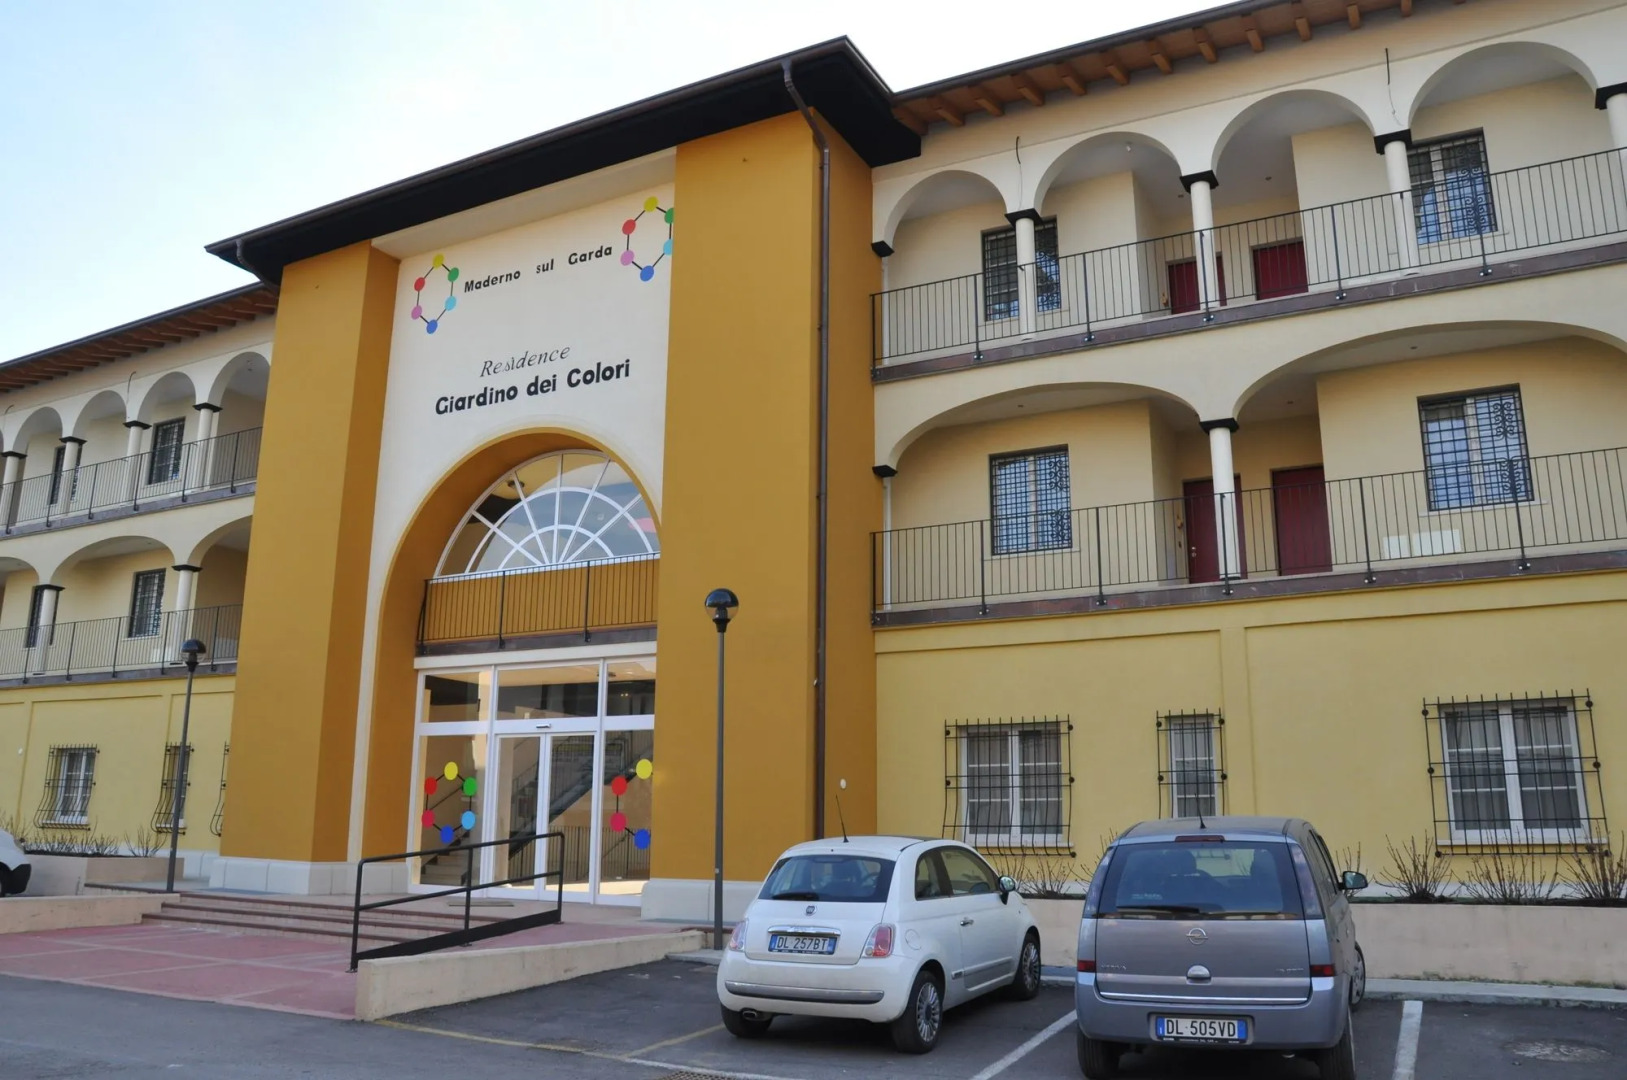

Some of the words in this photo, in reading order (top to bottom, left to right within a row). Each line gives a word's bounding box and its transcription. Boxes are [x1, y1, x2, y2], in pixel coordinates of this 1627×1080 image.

[464, 270, 521, 293] Maderno
[535, 258, 555, 274] sul
[567, 245, 613, 266] Garda
[435, 386, 518, 415] Giardino
[526, 373, 557, 397] dei
[566, 358, 630, 388] Colori
[1190, 1021, 1236, 1037] 505VD
